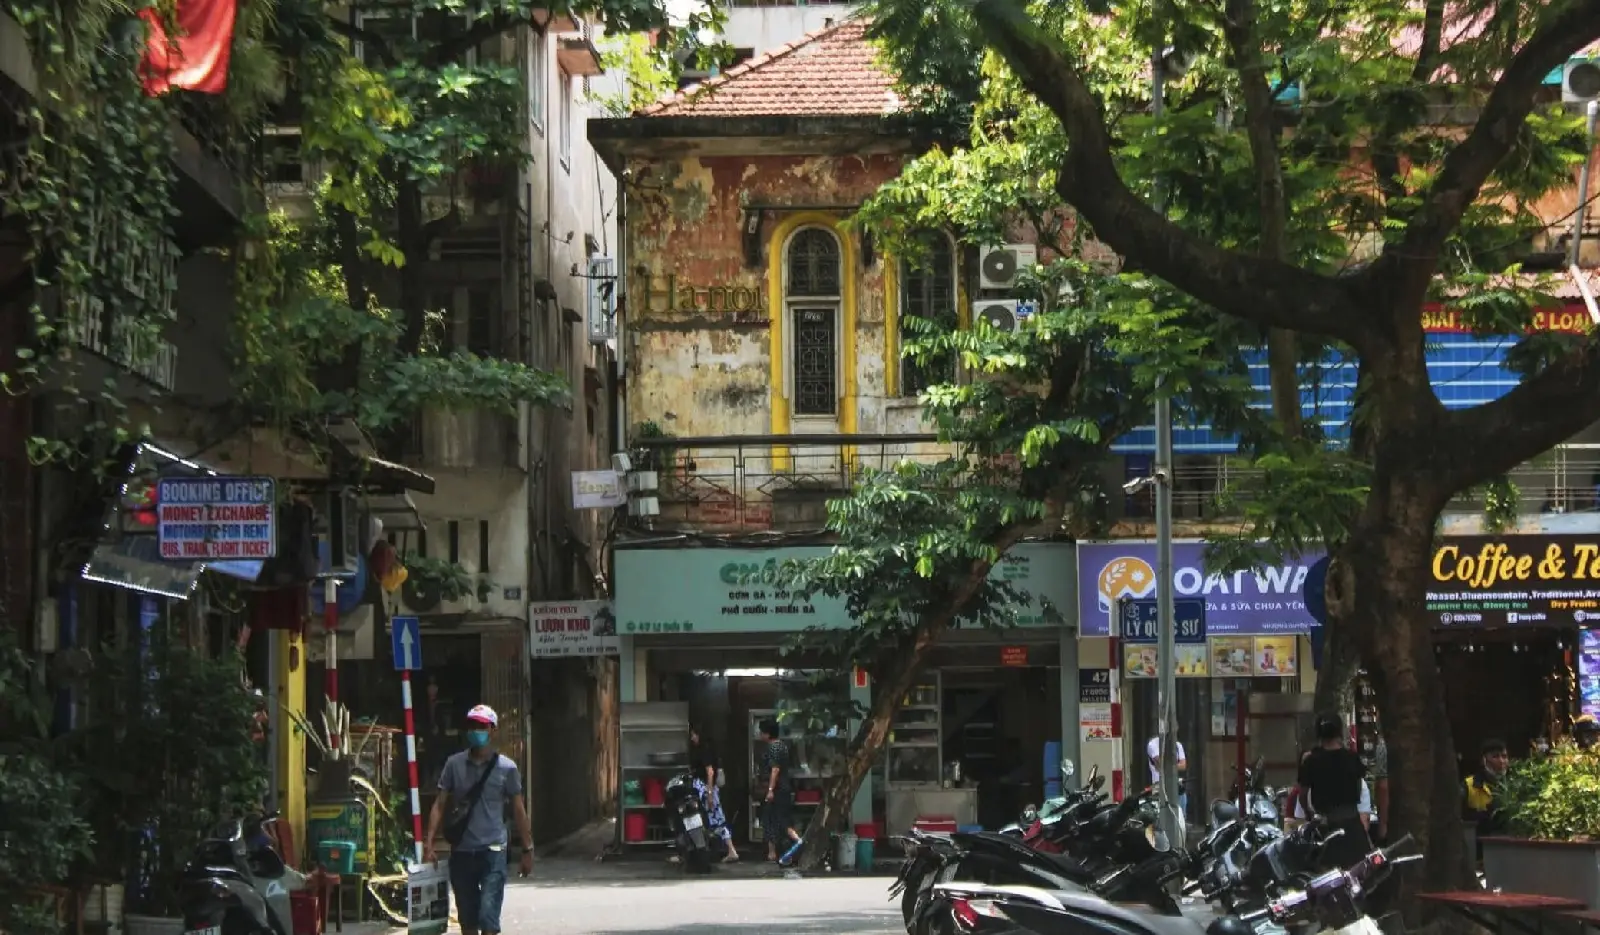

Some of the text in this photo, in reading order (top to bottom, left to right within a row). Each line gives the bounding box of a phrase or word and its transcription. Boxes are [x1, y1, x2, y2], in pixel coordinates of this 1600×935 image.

[162, 482, 270, 501] BOOKING OFFICE
[163, 504, 270, 521] MONEY EXCHANGE
[222, 523, 241, 539] FOR
[243, 523, 269, 539] RENT
[212, 541, 240, 556] FLIGHT
[242, 541, 270, 556] TICKET
[1432, 543, 1533, 588] Coffee
[1538, 543, 1566, 580] &
[1254, 602, 1282, 611] CHUA
[1551, 600, 1597, 610] Dry Fruits
[1181, 618, 1199, 636] SƯ
[1092, 671, 1108, 683] 47
